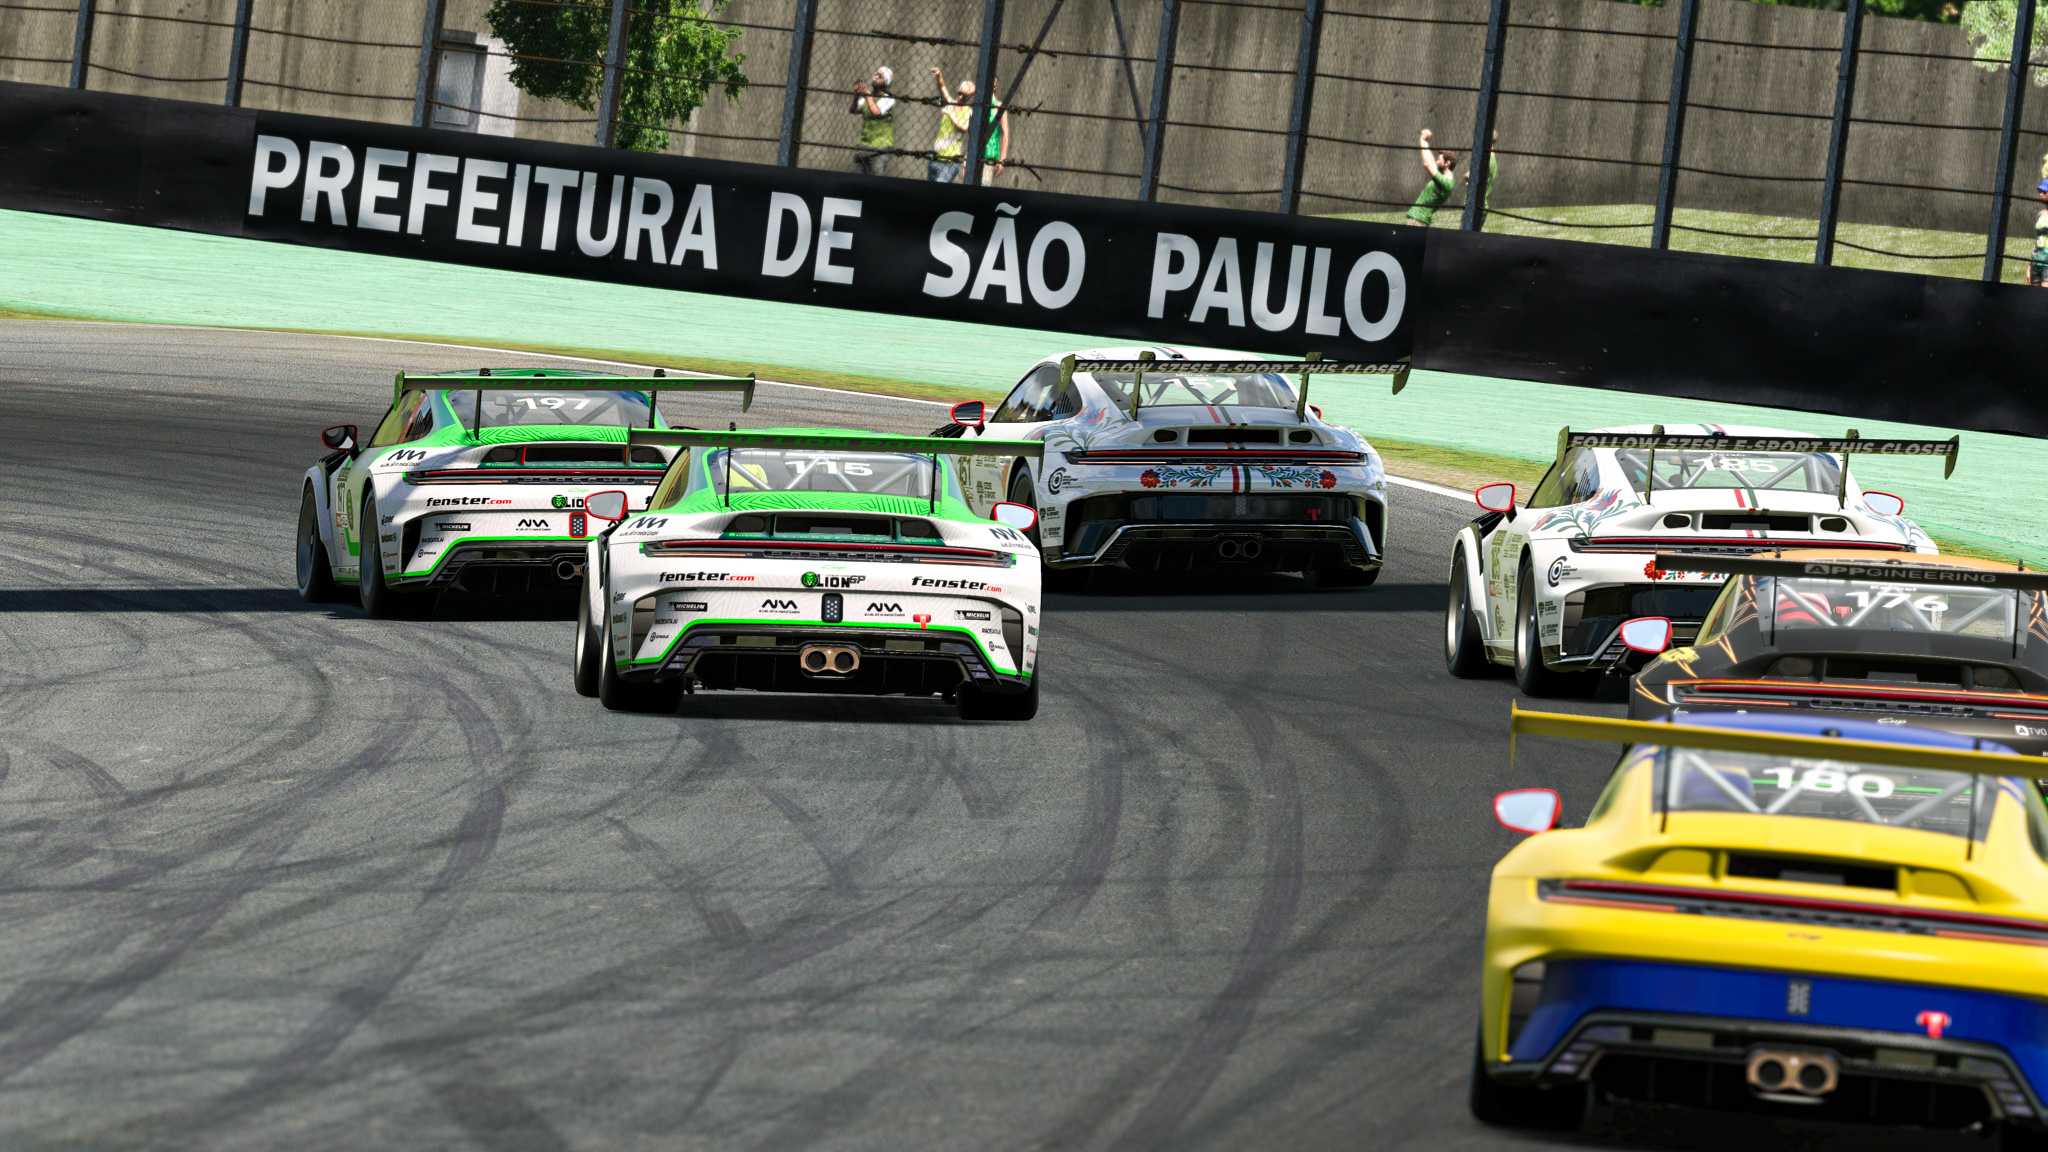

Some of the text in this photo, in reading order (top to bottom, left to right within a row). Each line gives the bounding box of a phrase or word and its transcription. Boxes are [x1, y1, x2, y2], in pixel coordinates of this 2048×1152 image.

[248, 133, 1408, 342] PREFEITURA DE SÃO PAULO
[1075, 362, 1406, 375] FOLLOW SZESE E-SPORT THIS CLOSE!
[523, 380, 588, 388] LION
[594, 381, 695, 389] ROARS
[1164, 378, 1237, 391] 151
[516, 397, 591, 410] 197
[701, 435, 975, 450] THE LION ROARS
[1571, 435, 1955, 456] FOLLOW SZESE E-SPORT THIS CLOSE!
[785, 460, 873, 476] 115
[1693, 458, 1779, 473] 185
[426, 496, 512, 507] fenster.com
[565, 496, 584, 508] LIO
[658, 571, 755, 583] fenster.com
[1804, 563, 1997, 584] APPGINEERING
[911, 575, 1002, 593] fenster.com
[1845, 591, 1949, 611] 176
[1877, 716, 1907, 726] Cup
[1763, 766, 1896, 798] 180
